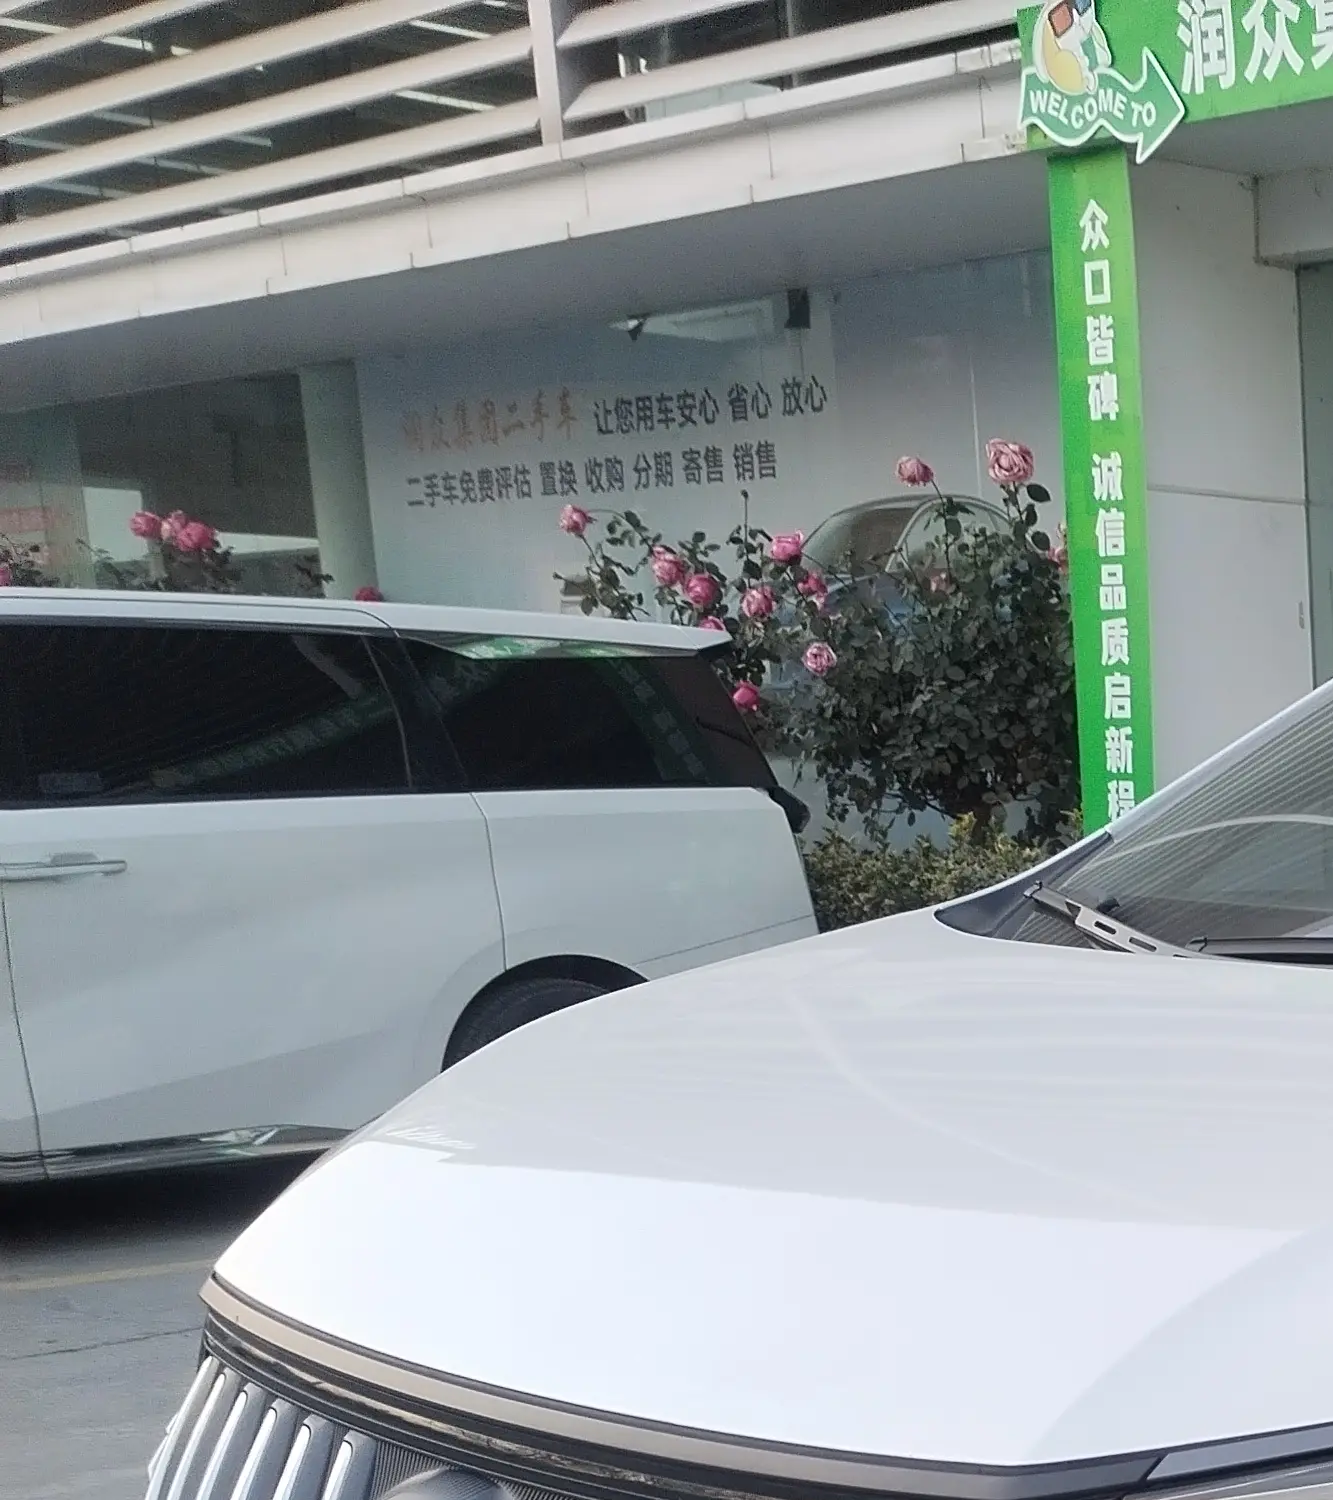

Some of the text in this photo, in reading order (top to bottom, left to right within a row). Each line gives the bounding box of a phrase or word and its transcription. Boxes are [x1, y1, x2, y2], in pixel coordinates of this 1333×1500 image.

[1029, 87, 1157, 129] WELCOME TO
[1079, 198, 1120, 421] 众口皆碑
[593, 386, 720, 436] 让您用车安心
[727, 381, 773, 423] 省心
[781, 374, 828, 418] 放心
[406, 438, 777, 508] 二手车免费评估 置换 收购 分期 寄售 销售
